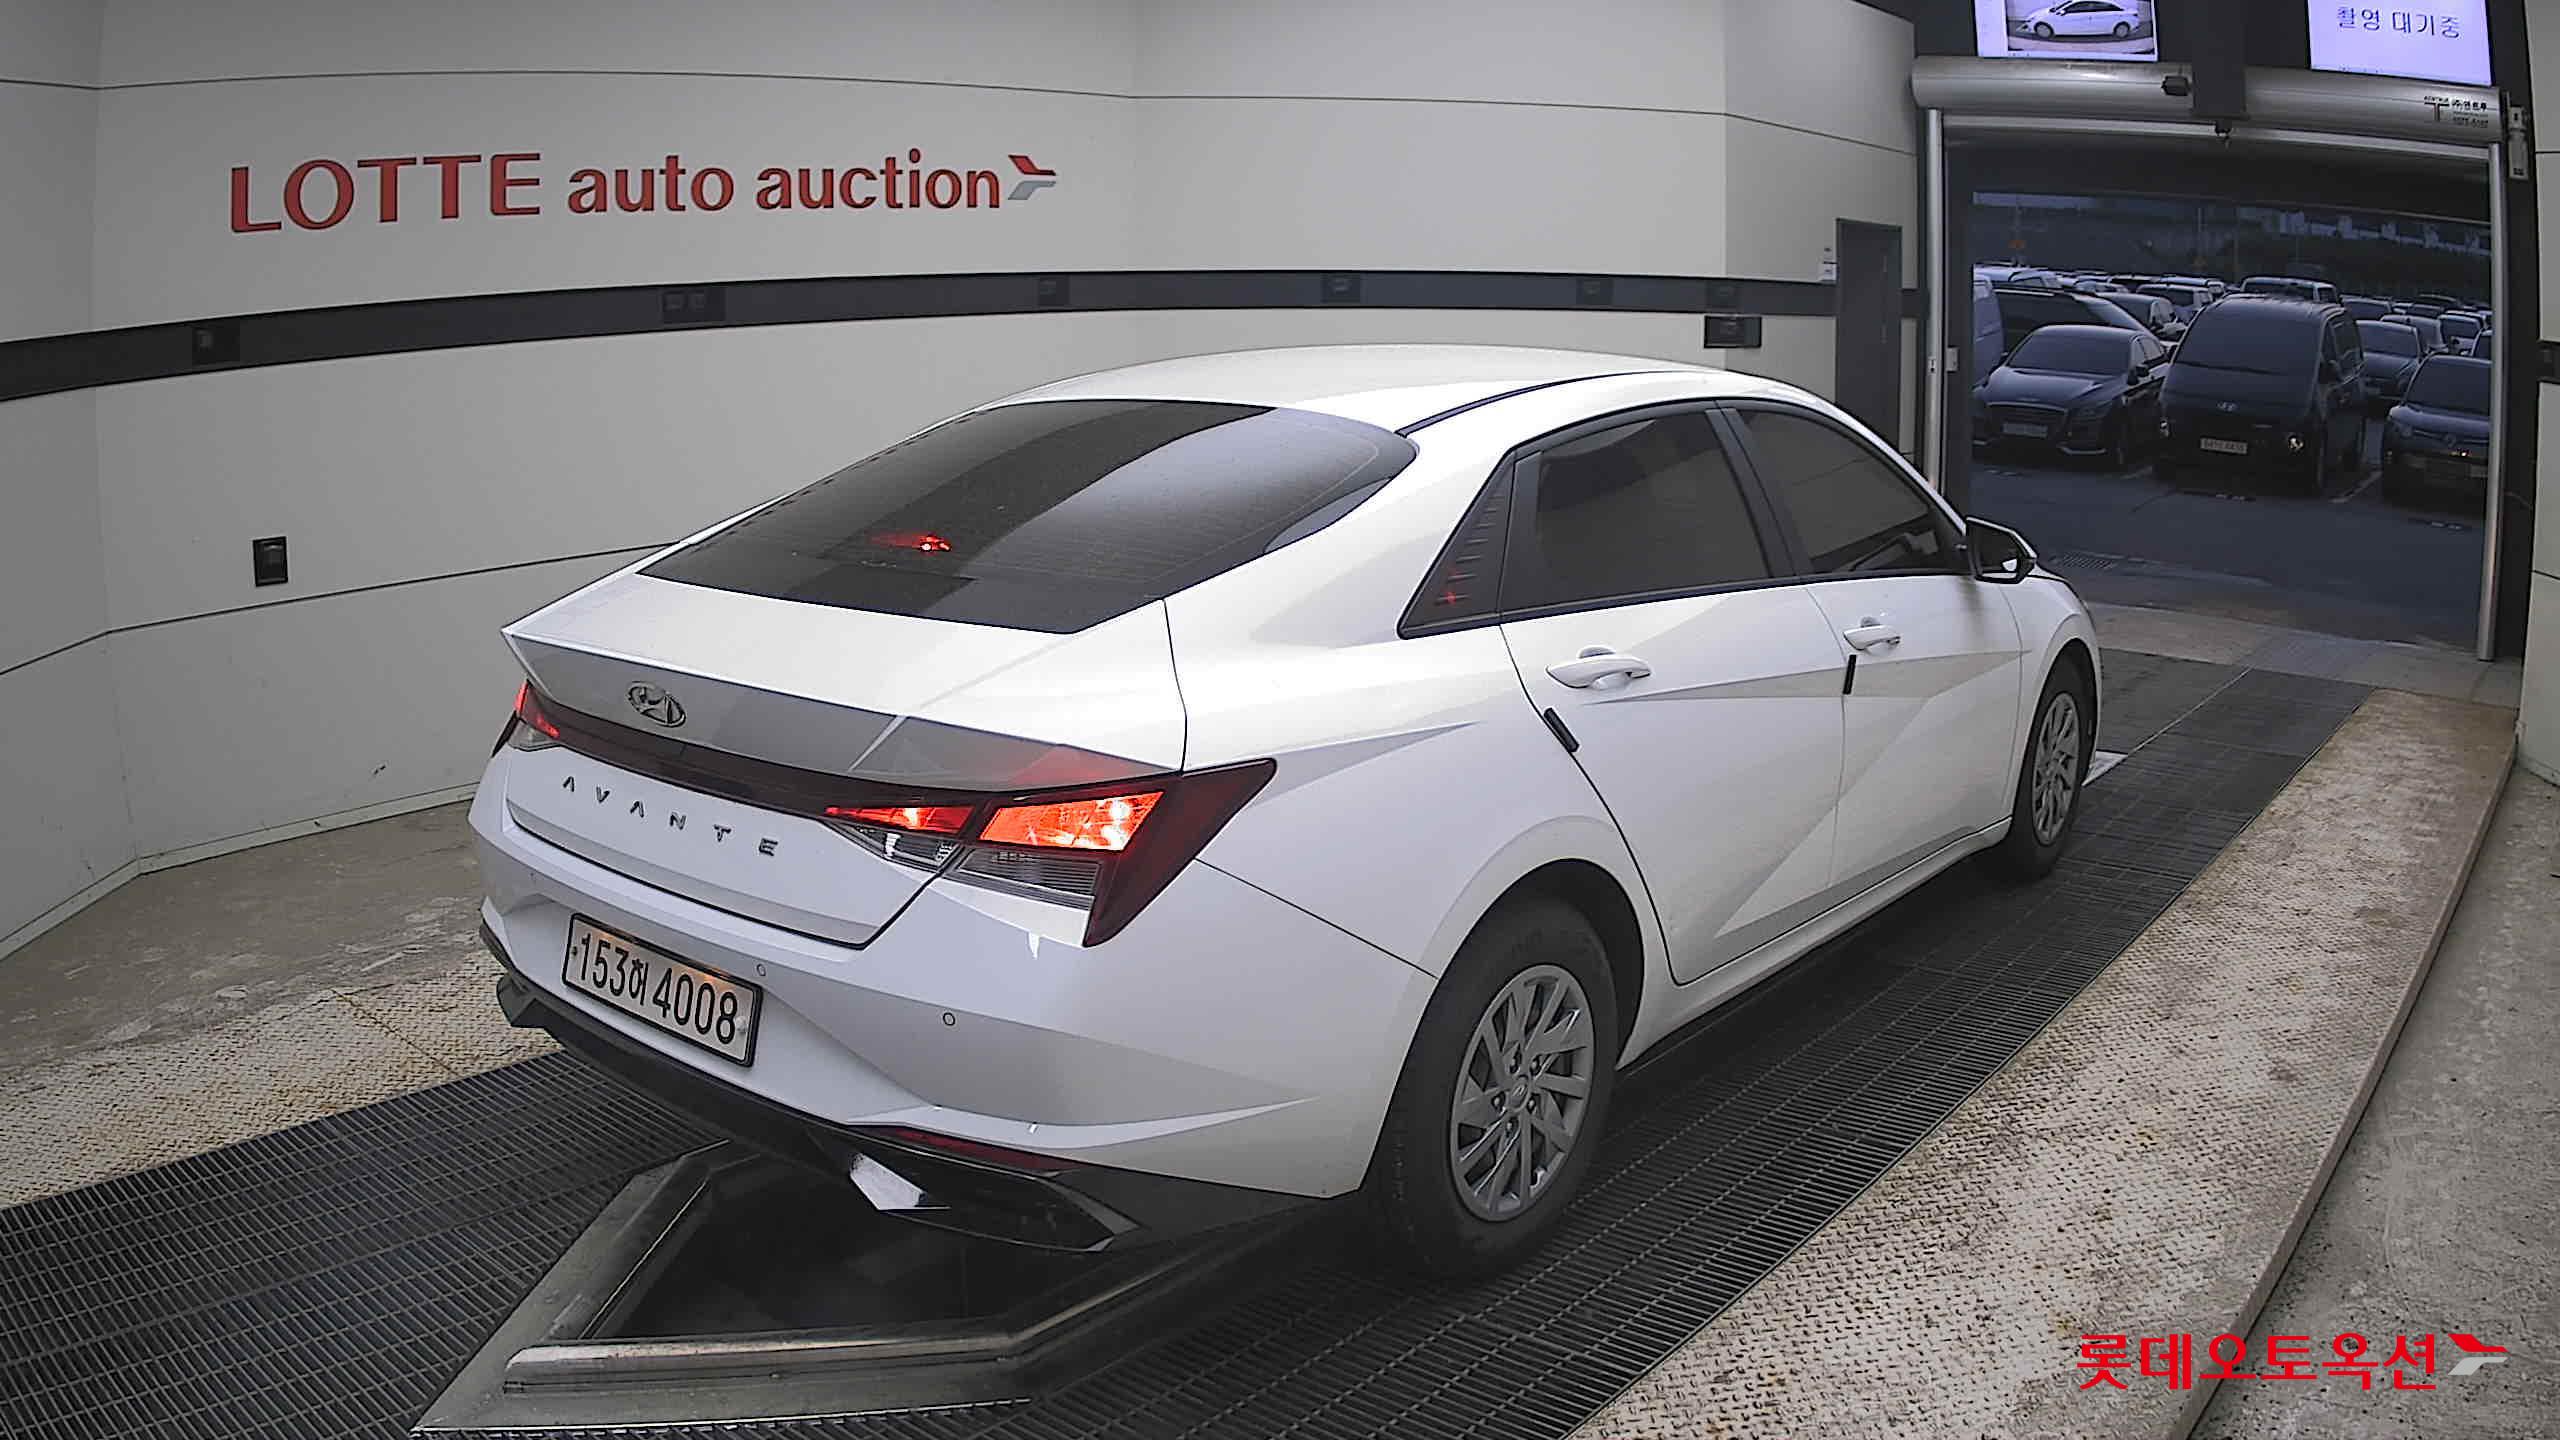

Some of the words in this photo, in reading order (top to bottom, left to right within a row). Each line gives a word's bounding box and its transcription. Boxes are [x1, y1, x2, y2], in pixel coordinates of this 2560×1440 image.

[2336, 6, 2380, 31] 촬영
[2391, 11, 2460, 39] 대기중
[230, 152, 542, 233] LOTTE
[568, 154, 735, 213] auto
[756, 147, 1001, 210] auction
[562, 775, 779, 857] AVANTE
[652, 967, 739, 1045] 4008
